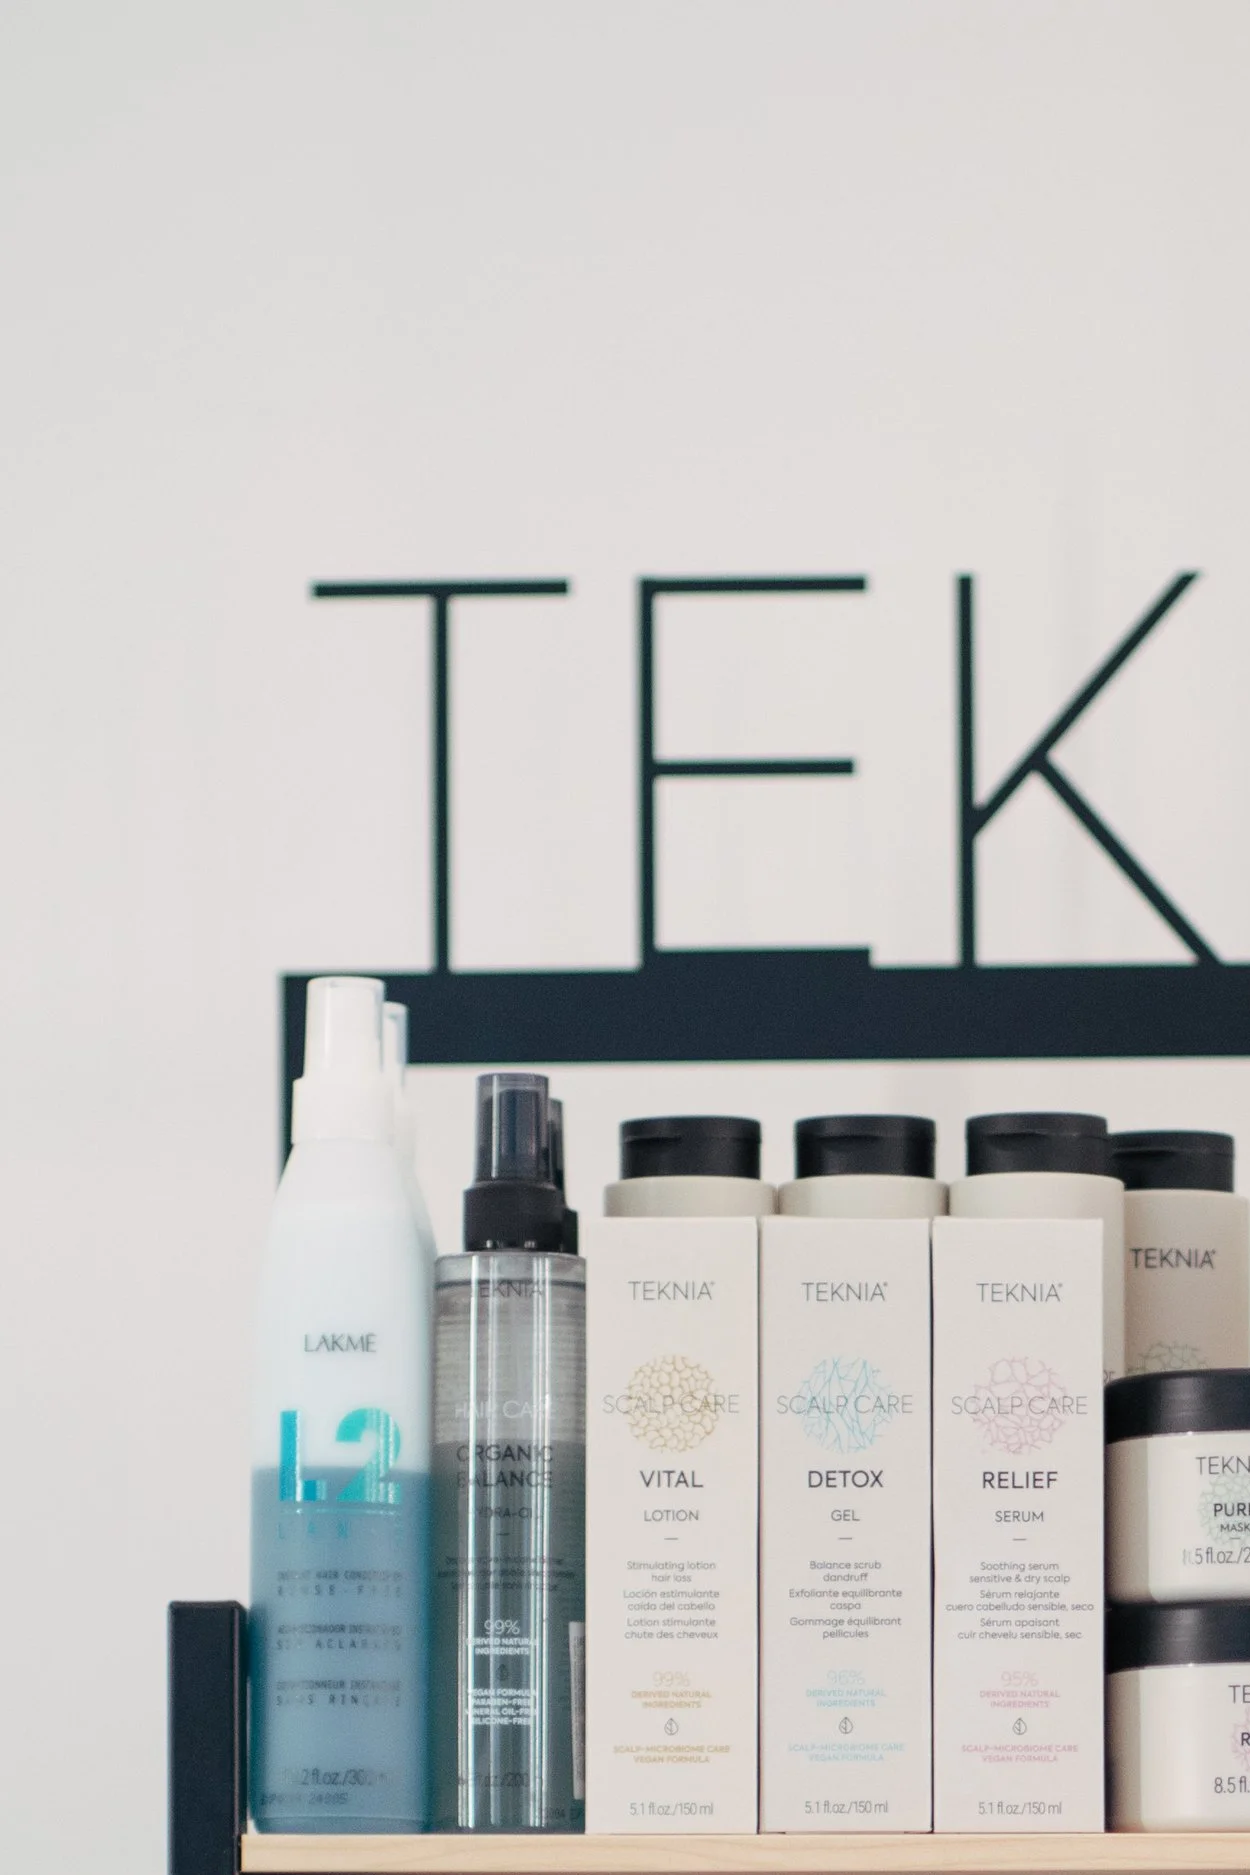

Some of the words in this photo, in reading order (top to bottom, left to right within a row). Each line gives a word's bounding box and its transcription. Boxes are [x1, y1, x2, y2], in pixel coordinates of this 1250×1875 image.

[602, 1393, 674, 1415] SCALP
[680, 1393, 741, 1415] CARE
[950, 1394, 1022, 1417] SCALP
[1027, 1394, 1088, 1417] CARE
[278, 1408, 404, 1504] L2
[639, 1469, 705, 1490] VITAL
[807, 1469, 885, 1490] DETOX
[982, 1470, 1059, 1491] RELIEF
[643, 1508, 700, 1524] LOTION
[830, 1508, 861, 1524] GEL
[994, 1509, 1045, 1524] SERUM
[626, 1561, 685, 1572] Stimulating
[687, 1561, 717, 1570] lotion
[979, 1561, 1026, 1572] Soothing
[651, 1573, 671, 1582] hair
[673, 1573, 693, 1582] loss
[969, 1573, 1012, 1583] sensitive
[1024, 1575, 1041, 1584] dry
[1043, 1574, 1072, 1583] scalp
[1212, 1773, 1236, 1796] 8.5
[629, 1802, 644, 1816] 5.1
[699, 1803, 715, 1814] ml
